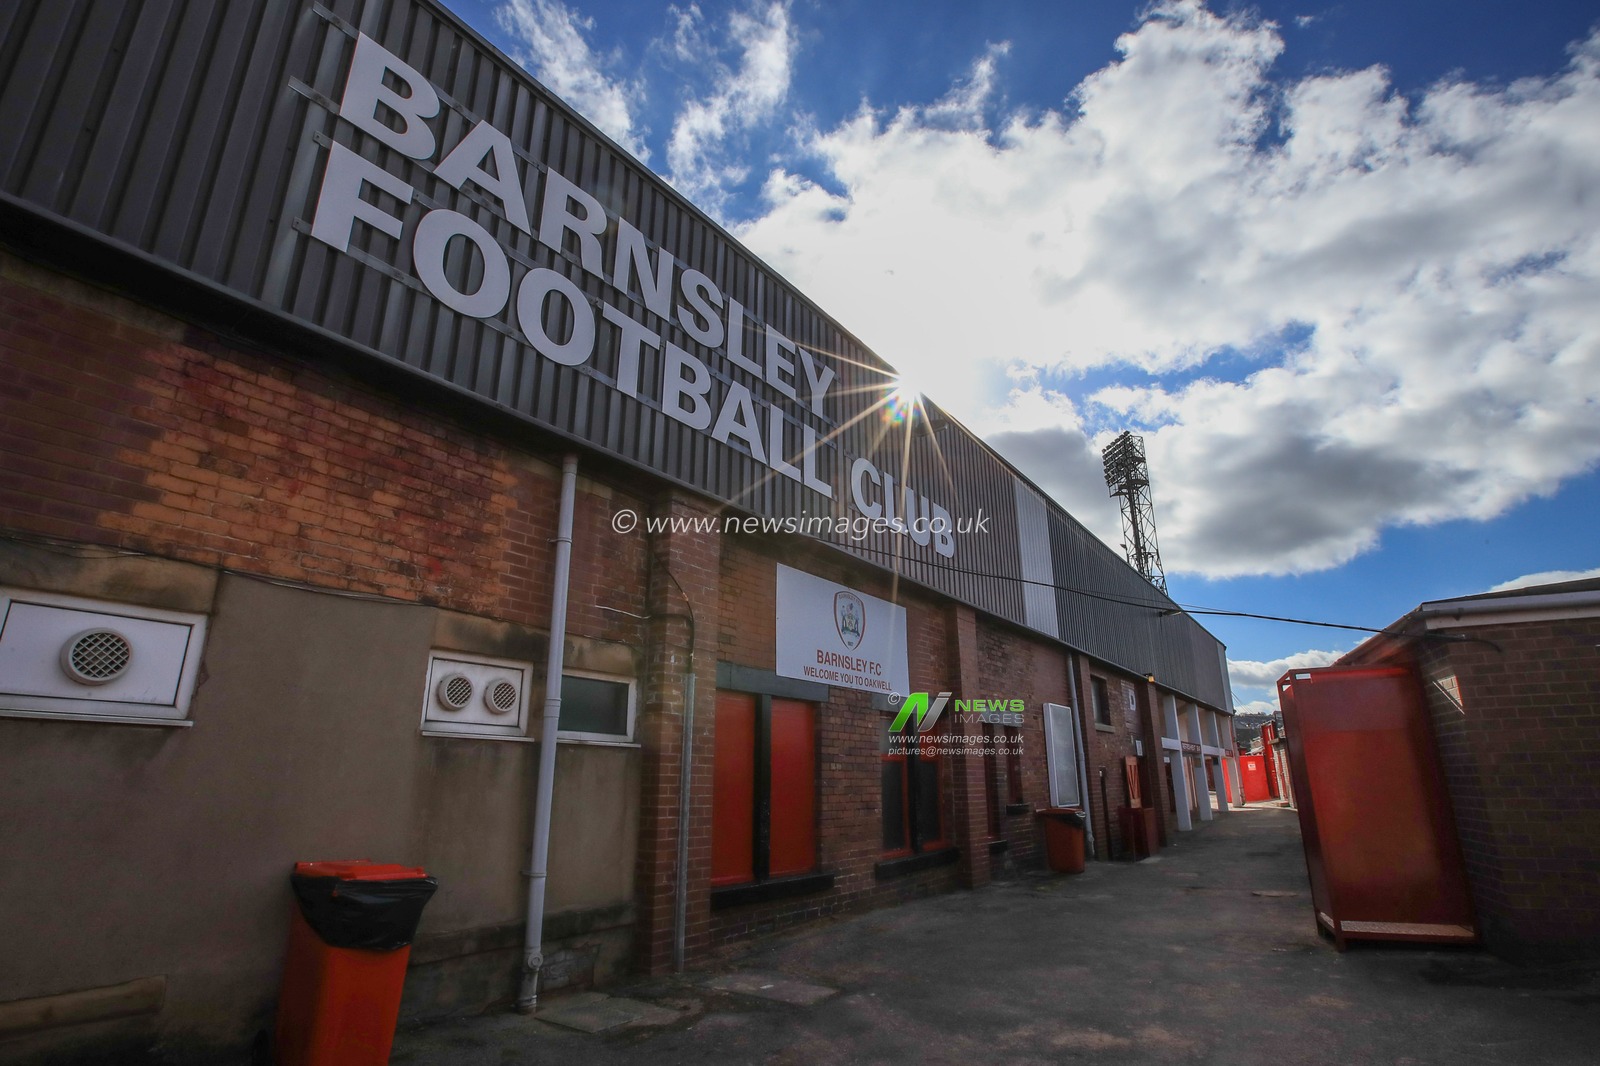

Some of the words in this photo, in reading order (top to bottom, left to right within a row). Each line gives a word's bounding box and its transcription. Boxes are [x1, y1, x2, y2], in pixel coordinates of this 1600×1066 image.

[339, 31, 836, 418] BARNSLEY
[310, 140, 833, 499] FOOTBALL
[850, 457, 955, 559] CLUB
[803, 665, 839, 682] WELCOME
[840, 672, 854, 684] YOU
[854, 675, 864, 686] TO
[864, 677, 892, 691] OAKWELL
[816, 649, 868, 673] BARNSLEY
